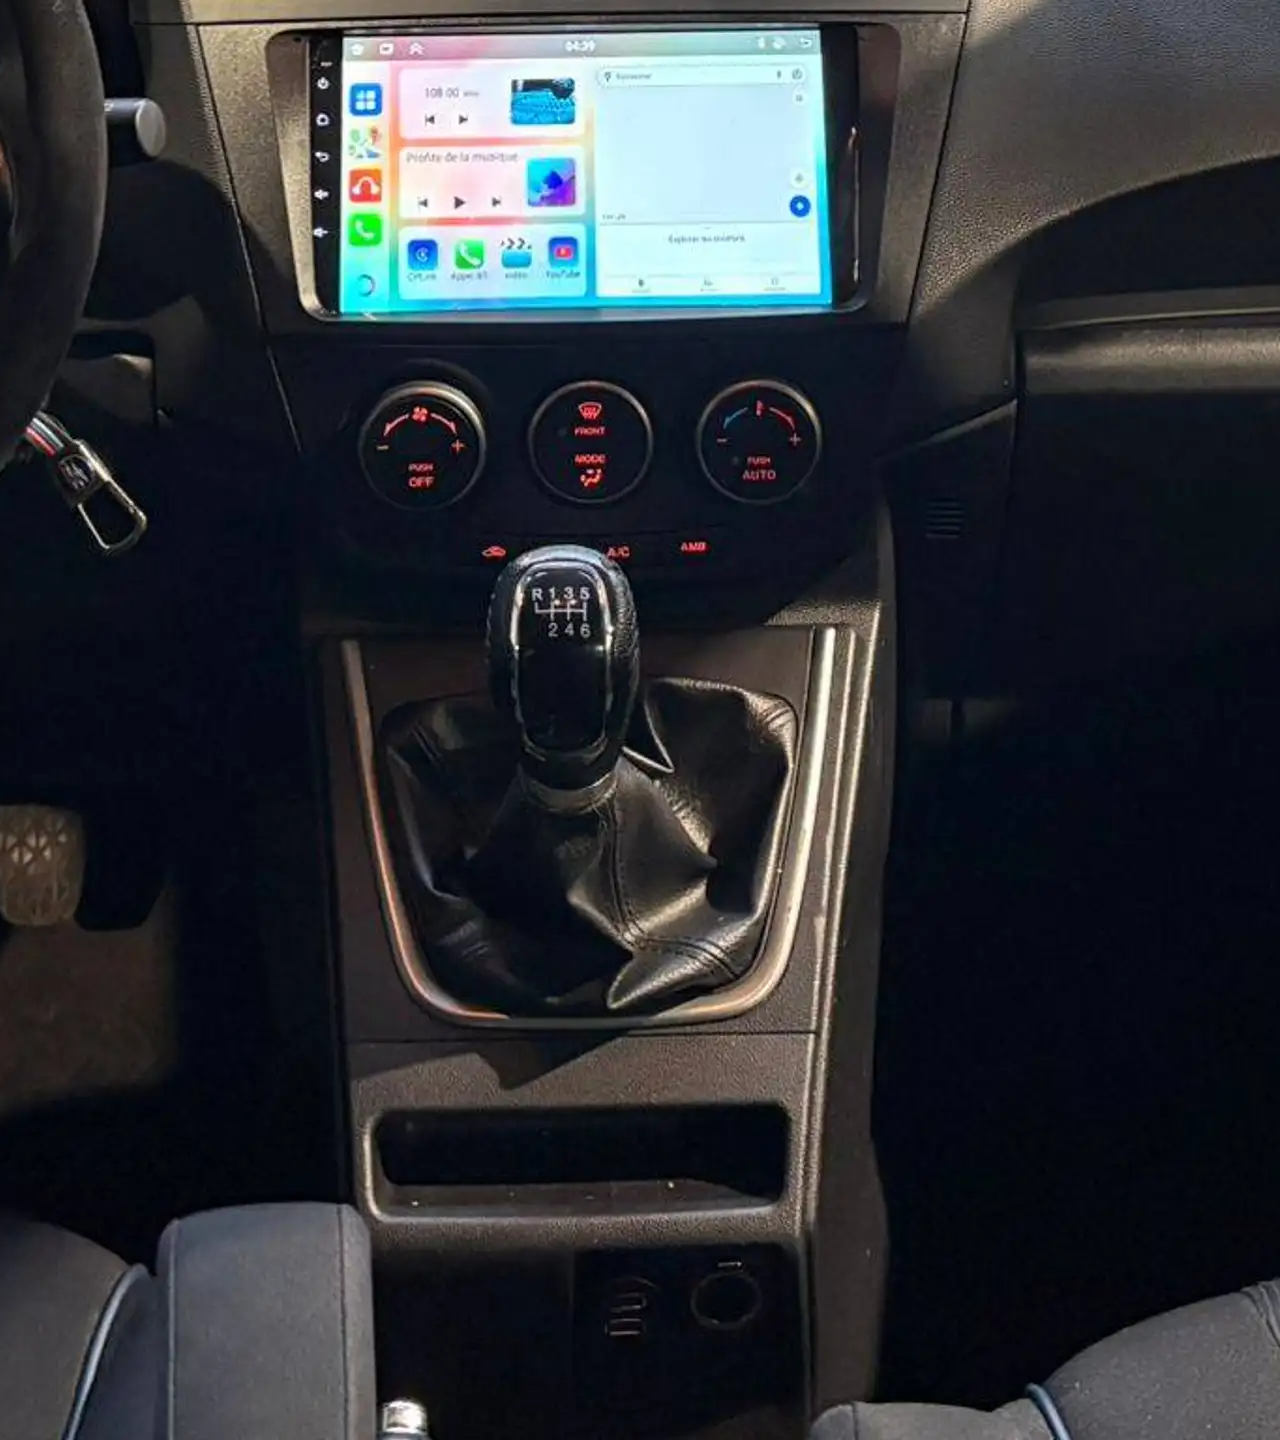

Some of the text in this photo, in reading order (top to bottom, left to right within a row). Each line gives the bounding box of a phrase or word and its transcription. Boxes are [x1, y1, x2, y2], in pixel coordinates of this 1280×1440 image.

[574, 426, 606, 436] FRONT
[574, 453, 606, 464] MODE
[742, 469, 777, 481] AUTO
[408, 476, 435, 488] OFF
[607, 546, 632, 559] A/C
[531, 587, 590, 601] R 1 3 5
[548, 623, 591, 638] 2 4 6
